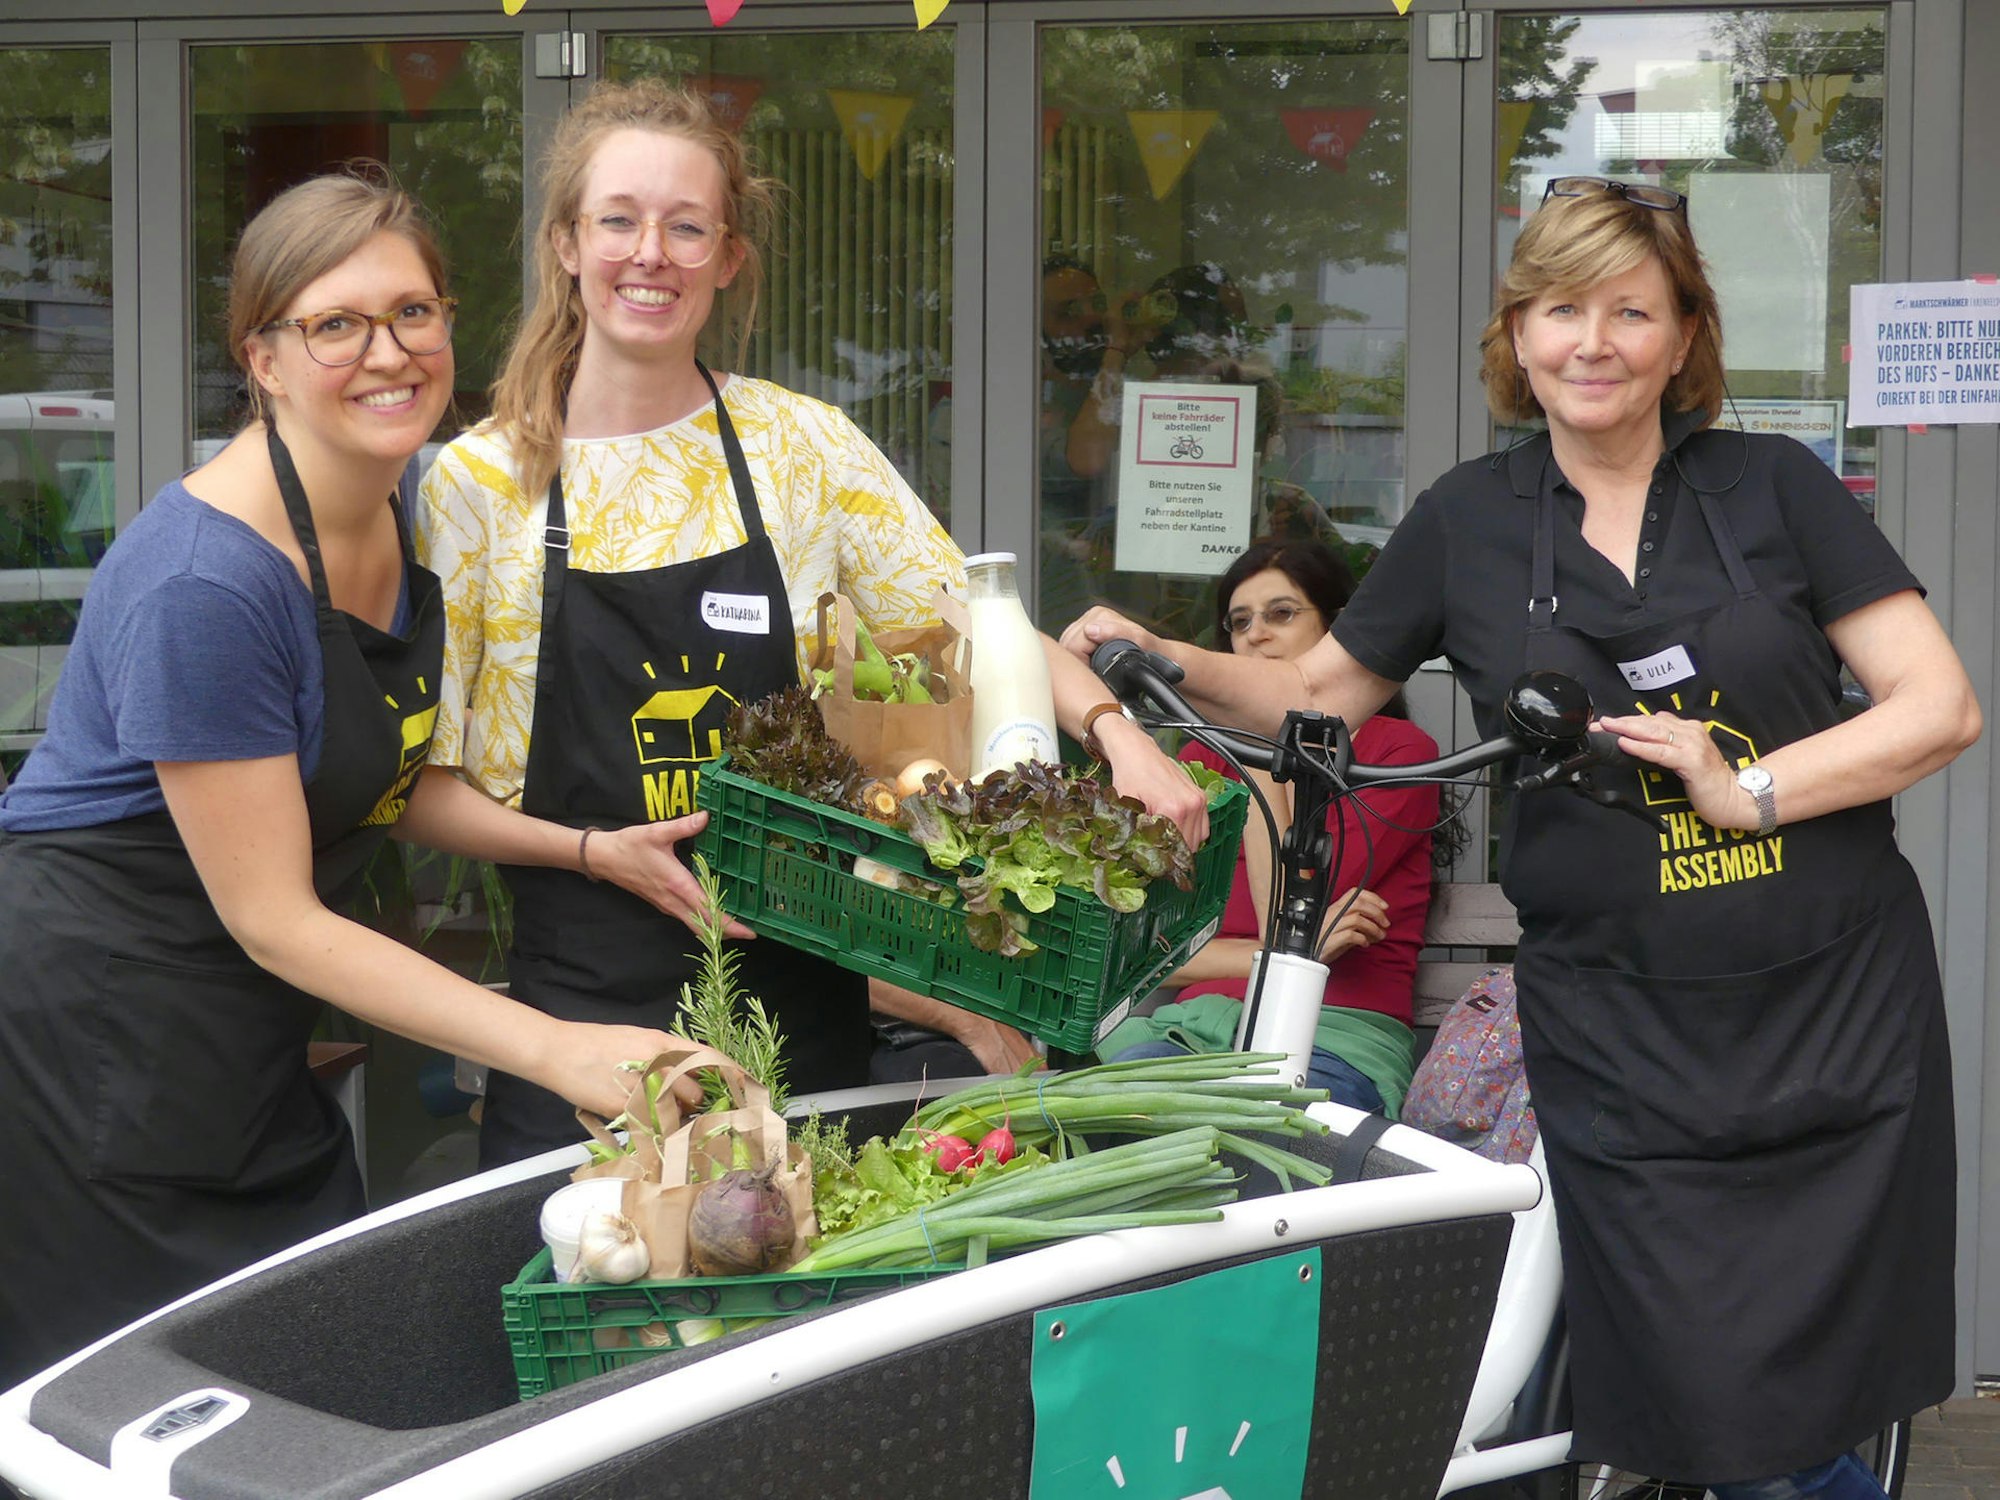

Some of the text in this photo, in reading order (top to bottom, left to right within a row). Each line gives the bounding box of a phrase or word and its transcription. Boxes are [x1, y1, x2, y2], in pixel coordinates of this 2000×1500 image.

[1878, 322, 1932, 341] PARKEN:
[1937, 320, 1973, 339] BITTE
[1877, 343, 1942, 363] VORDEREN
[1878, 366, 1901, 384] DES
[1905, 365, 1937, 383] HOFS
[1955, 363, 2000, 382] DANKE
[1876, 391, 1917, 408] (DIREKT
[1919, 390, 1935, 405] BEI
[1938, 389, 1958, 404] DER
[1177, 402, 1201, 412] Bitte
[1151, 411, 1226, 423] keine Fahrräder
[1164, 422, 1212, 433] abstellen!
[1149, 479, 1222, 492] Bitte nutzen Sie
[1165, 496, 1204, 505] unseren
[1144, 507, 1224, 520] Fahrradstellplatz
[1140, 521, 1227, 533] neben der Kantine
[720, 605, 762, 622] KATHARINA
[1647, 660, 1676, 679] ULLA
[1659, 836, 1783, 894] ASSEMBLY
